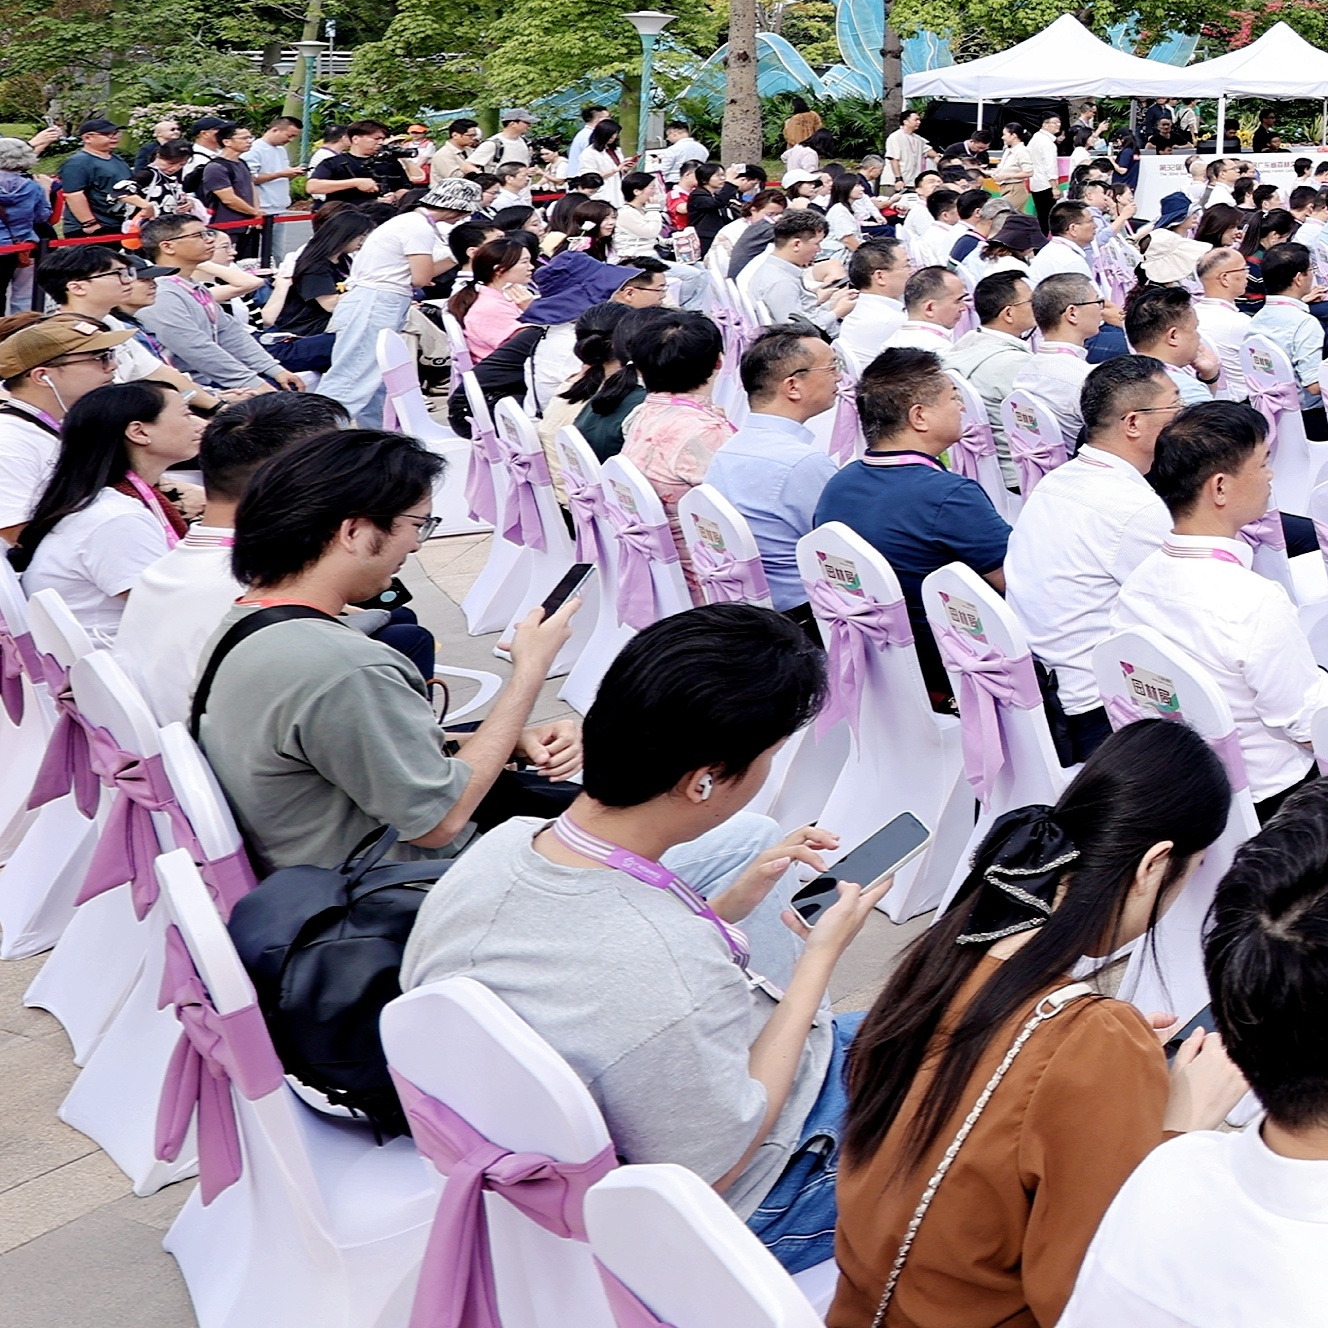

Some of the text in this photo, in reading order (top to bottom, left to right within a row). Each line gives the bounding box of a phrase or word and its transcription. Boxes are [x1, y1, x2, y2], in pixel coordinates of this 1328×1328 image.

[825, 564, 855, 585] 园林局
[1131, 678, 1173, 706] 园林局
